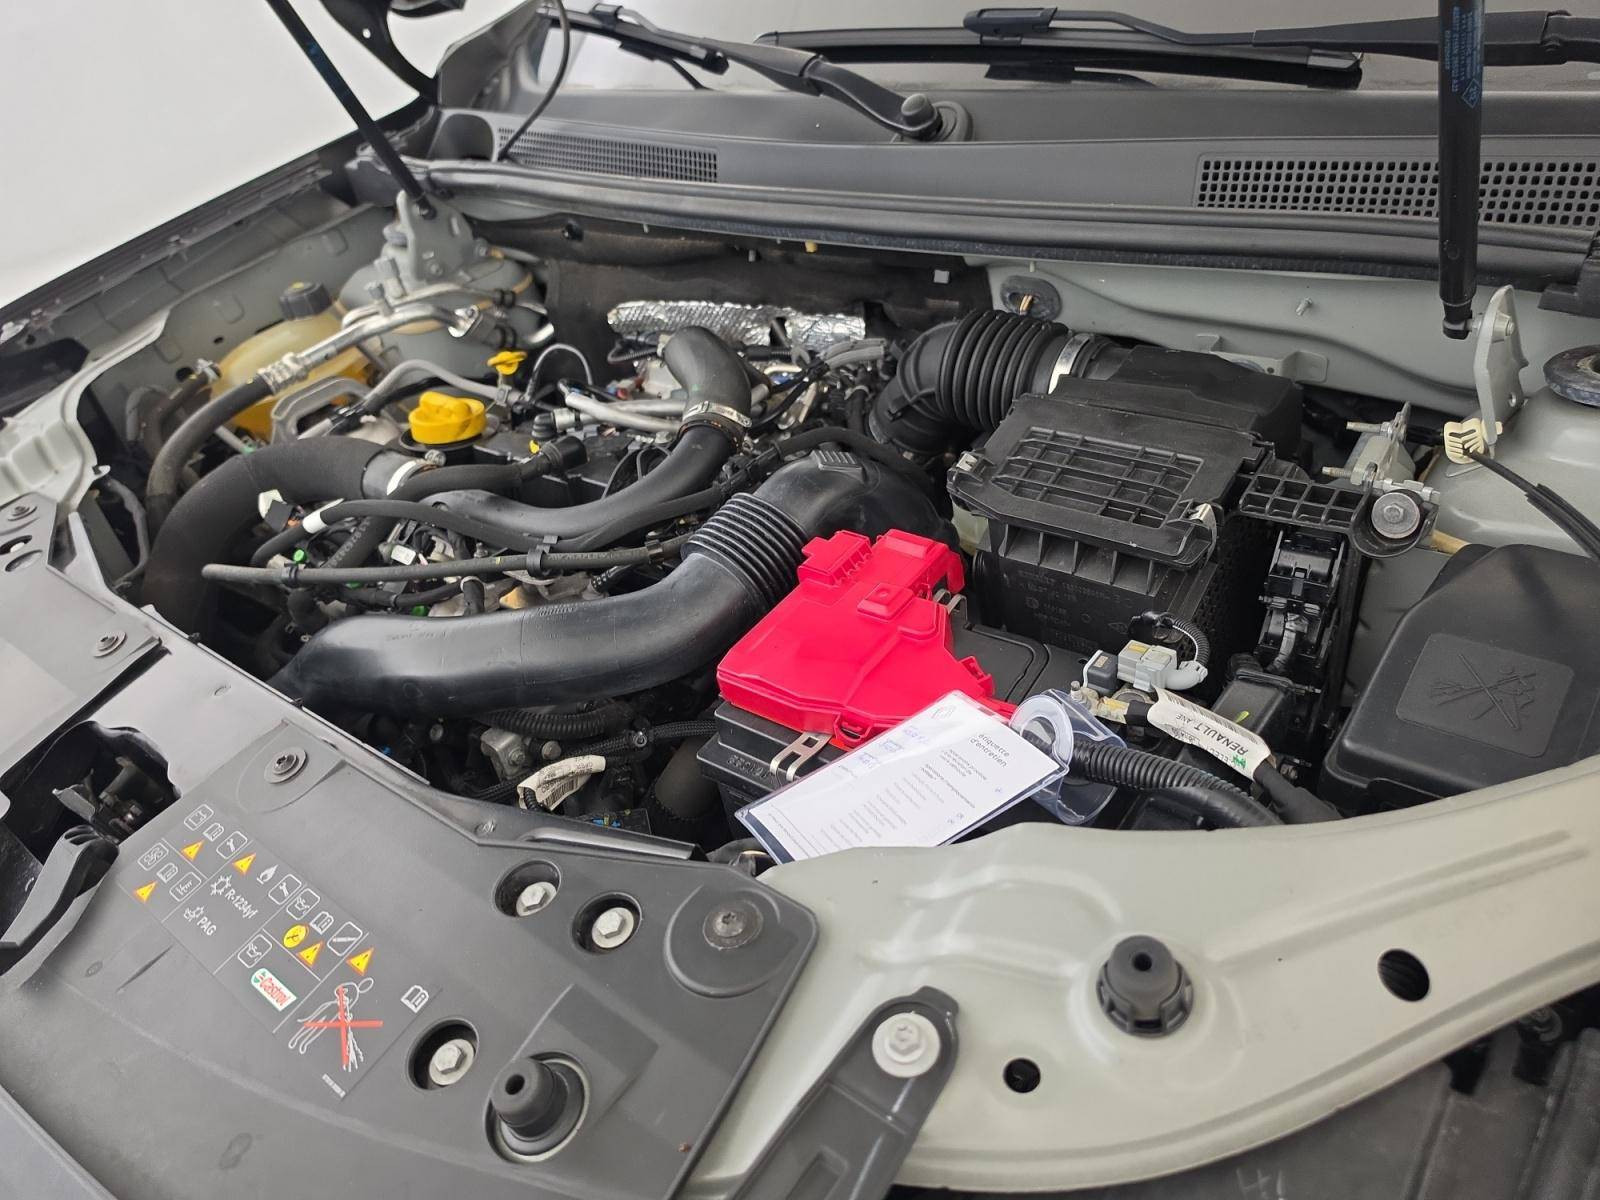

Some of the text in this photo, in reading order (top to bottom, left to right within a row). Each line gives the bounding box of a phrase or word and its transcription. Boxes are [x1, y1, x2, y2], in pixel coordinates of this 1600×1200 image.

[1193, 722, 1248, 756] RENAULT
[196, 916, 217, 936] PAG
[259, 977, 290, 1007] Castrol
